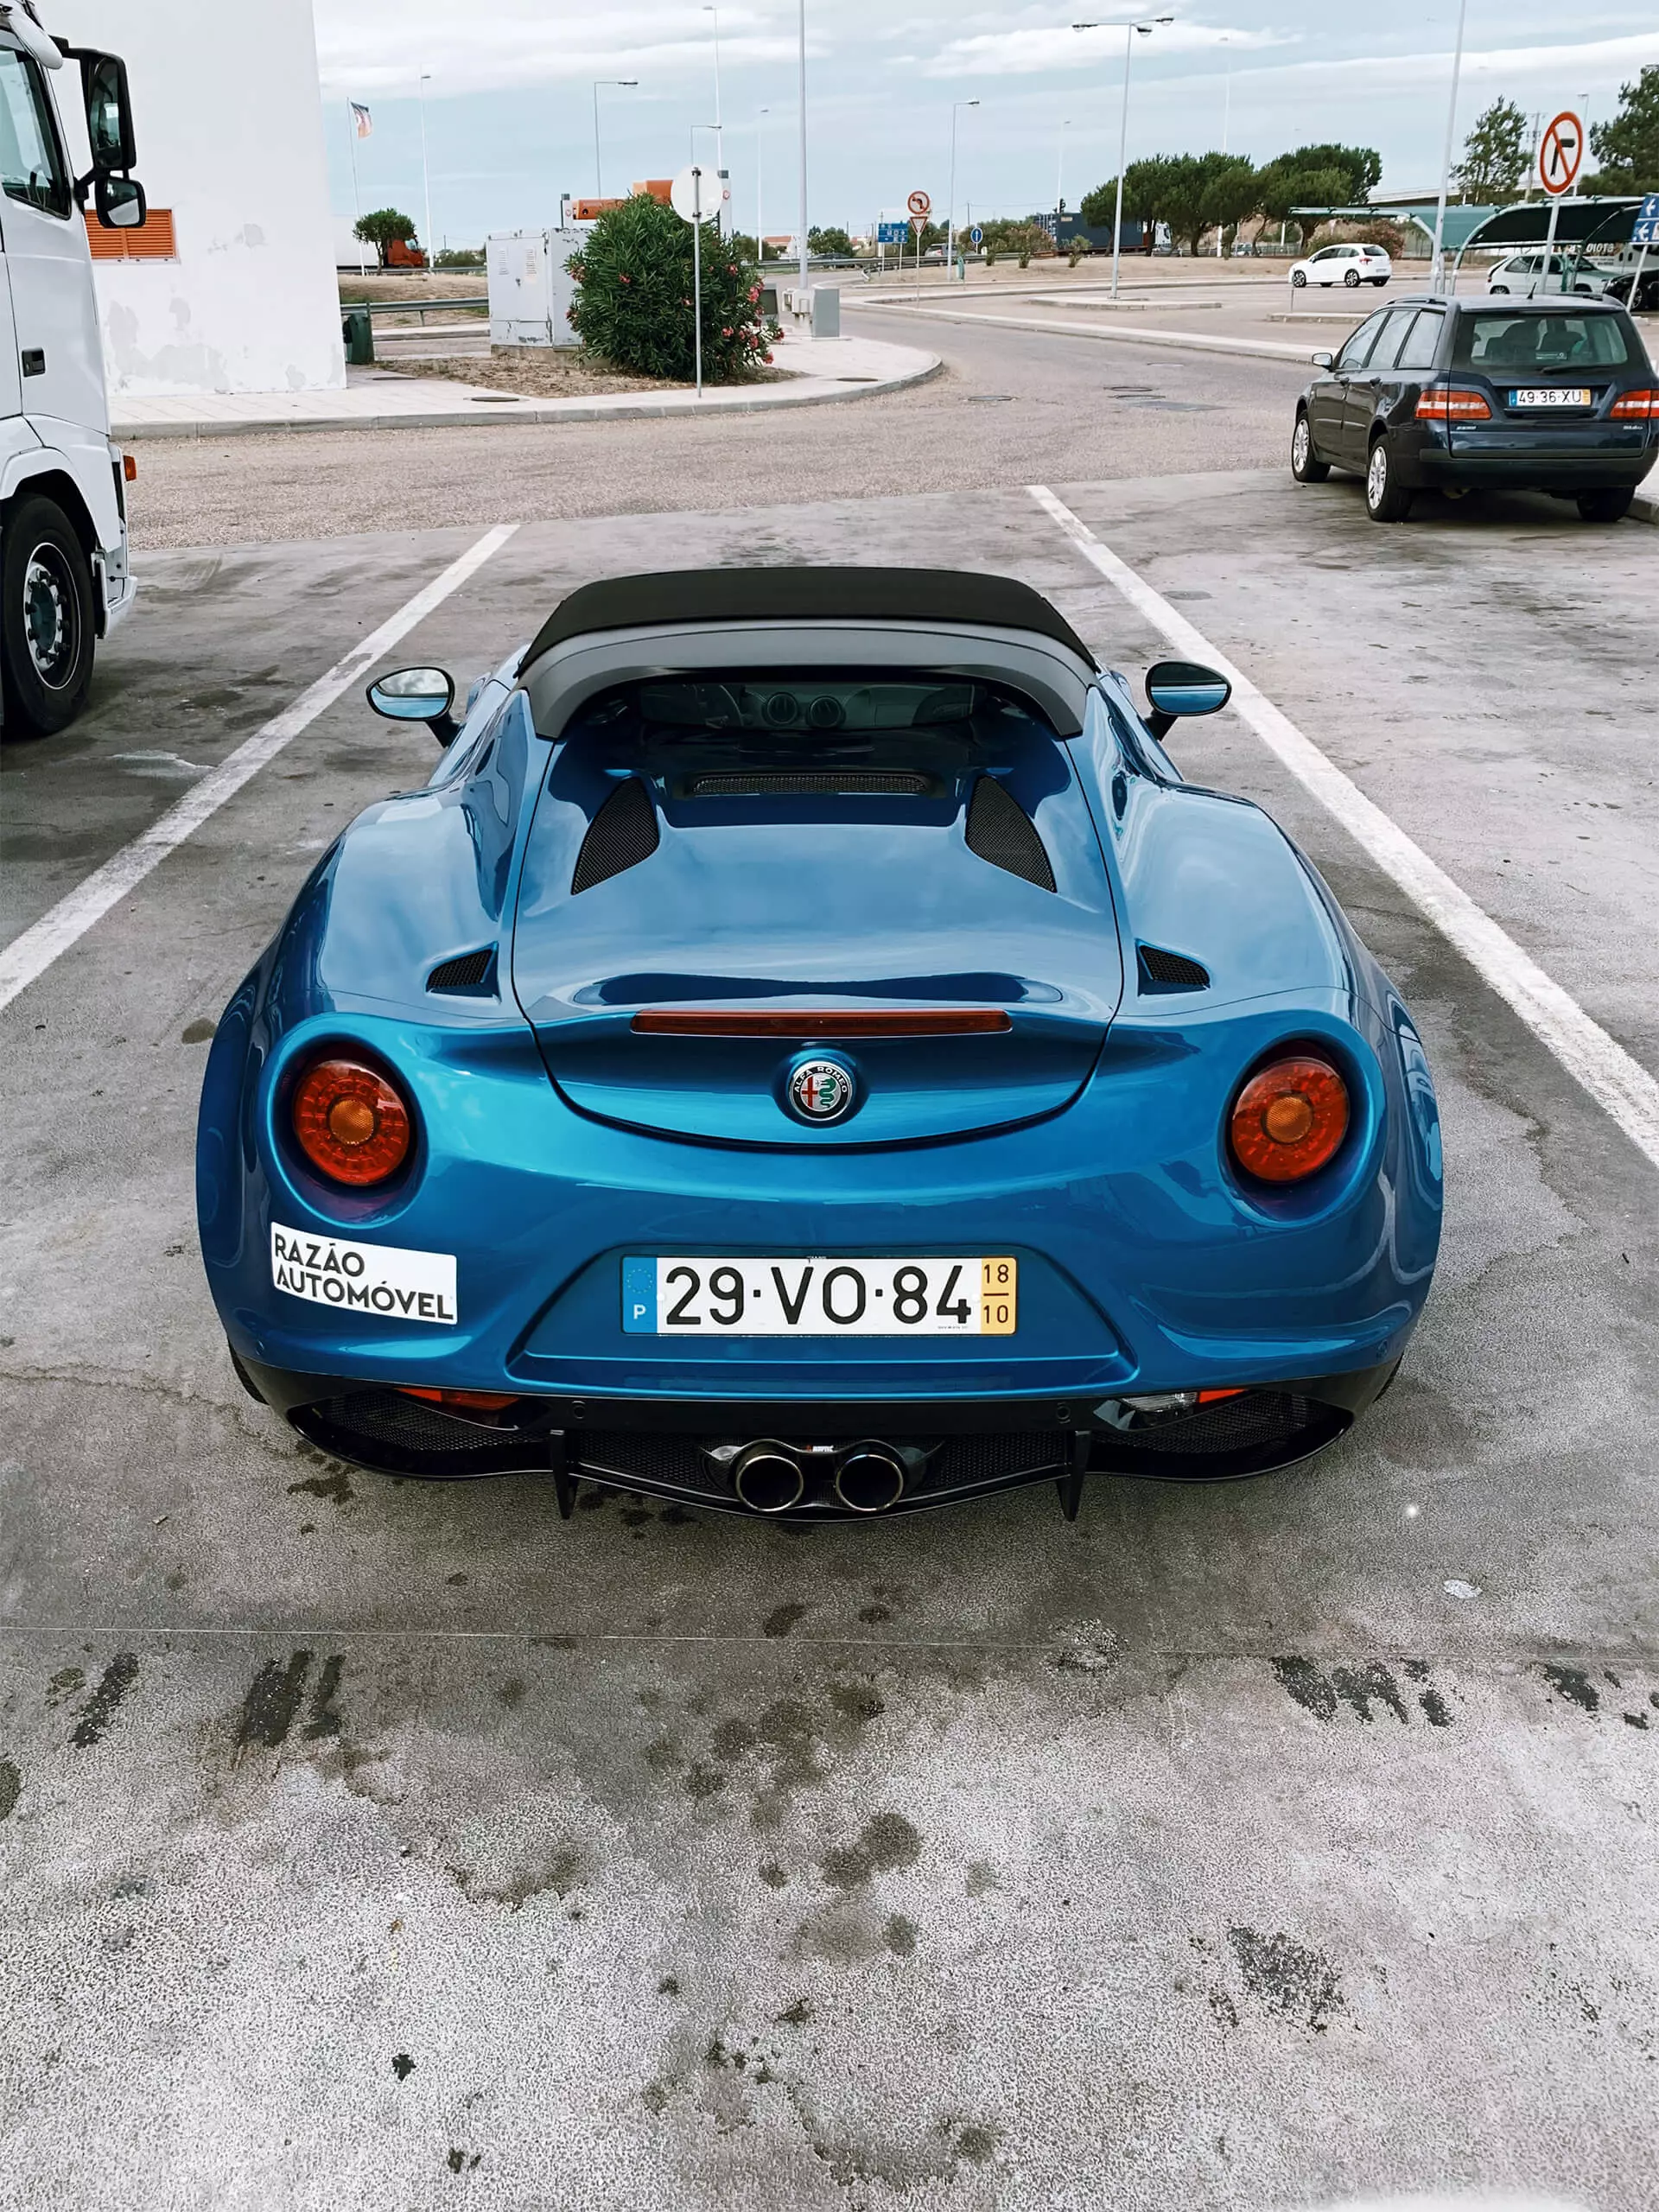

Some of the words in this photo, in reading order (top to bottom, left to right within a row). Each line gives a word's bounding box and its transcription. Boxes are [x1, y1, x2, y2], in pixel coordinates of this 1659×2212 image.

[794, 1070, 813, 1093] ALFA
[817, 1066, 848, 1093] ROMEO
[275, 1232, 365, 1277] RAZÃO
[984, 1264, 1009, 1284] 18
[276, 1264, 454, 1320] AUTOMÓVEL
[633, 1304, 646, 1319] P
[983, 1305, 1009, 1324] 10
